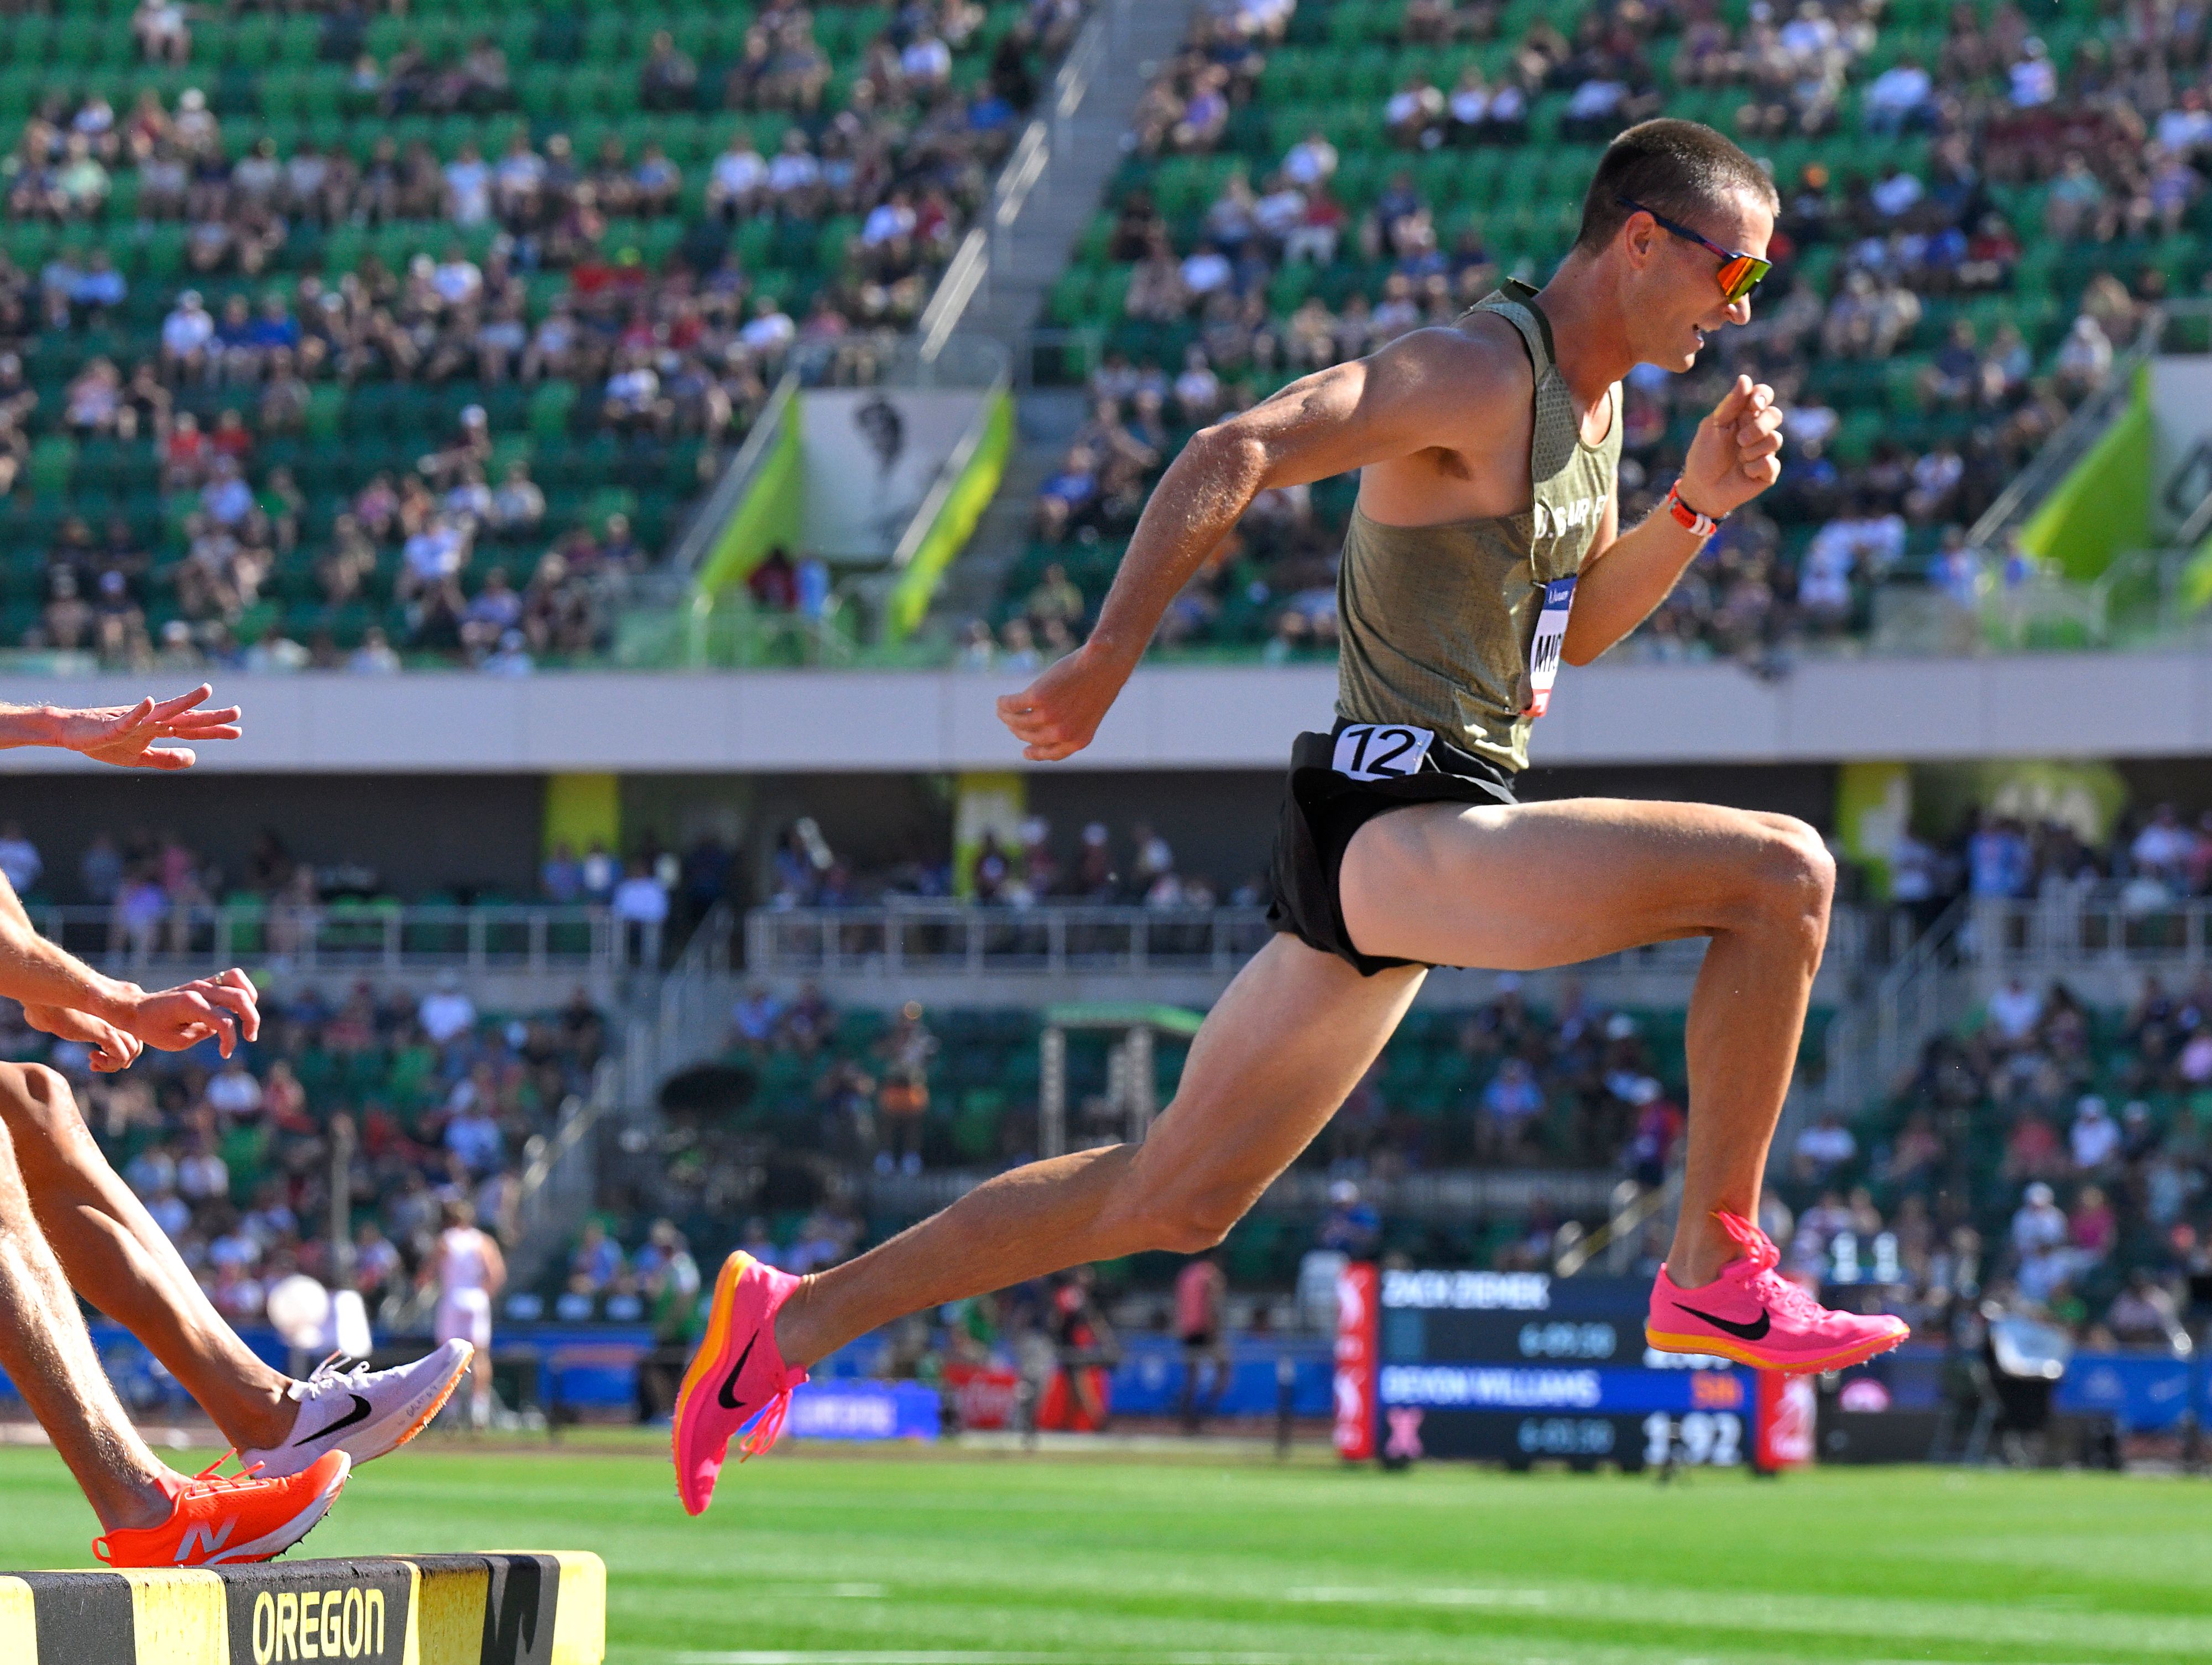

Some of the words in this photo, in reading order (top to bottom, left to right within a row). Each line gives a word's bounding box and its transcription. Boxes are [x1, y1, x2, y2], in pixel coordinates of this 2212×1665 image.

[1347, 727, 1416, 775] 12
[1384, 1370, 1470, 1401] DEVON
[1473, 1371, 1599, 1404] WILLIAMS
[252, 1587, 385, 1665] OREGON
